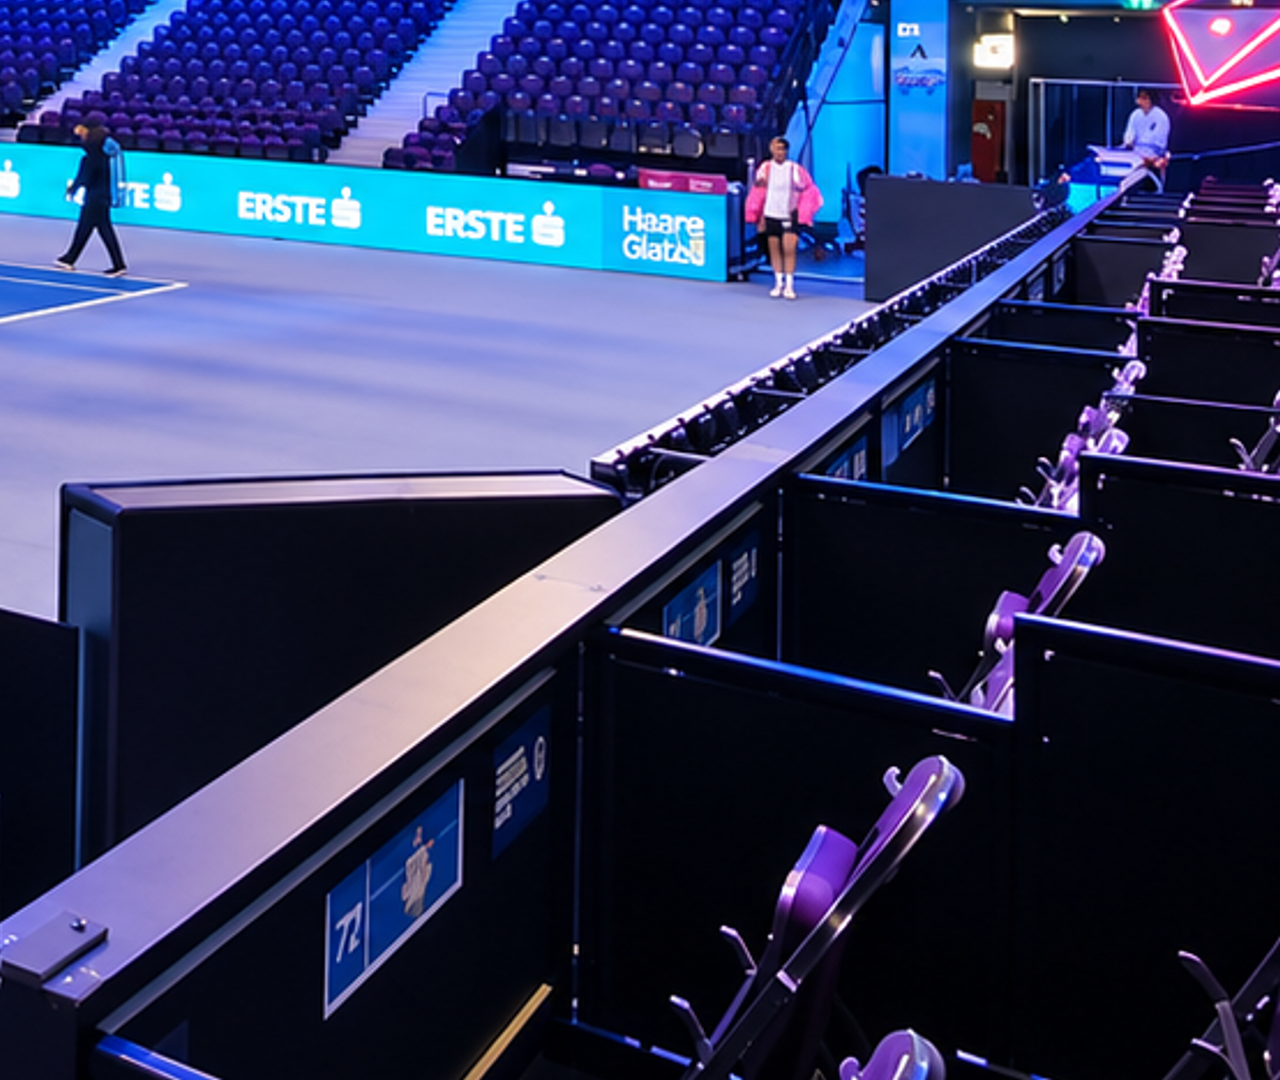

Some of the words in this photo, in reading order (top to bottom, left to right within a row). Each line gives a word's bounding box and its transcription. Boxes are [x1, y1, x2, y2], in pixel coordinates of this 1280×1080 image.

[237, 190, 326, 226] ERSTE
[426, 205, 525, 244] ERSTE
[622, 205, 705, 238] Haare
[335, 901, 363, 964] 72
